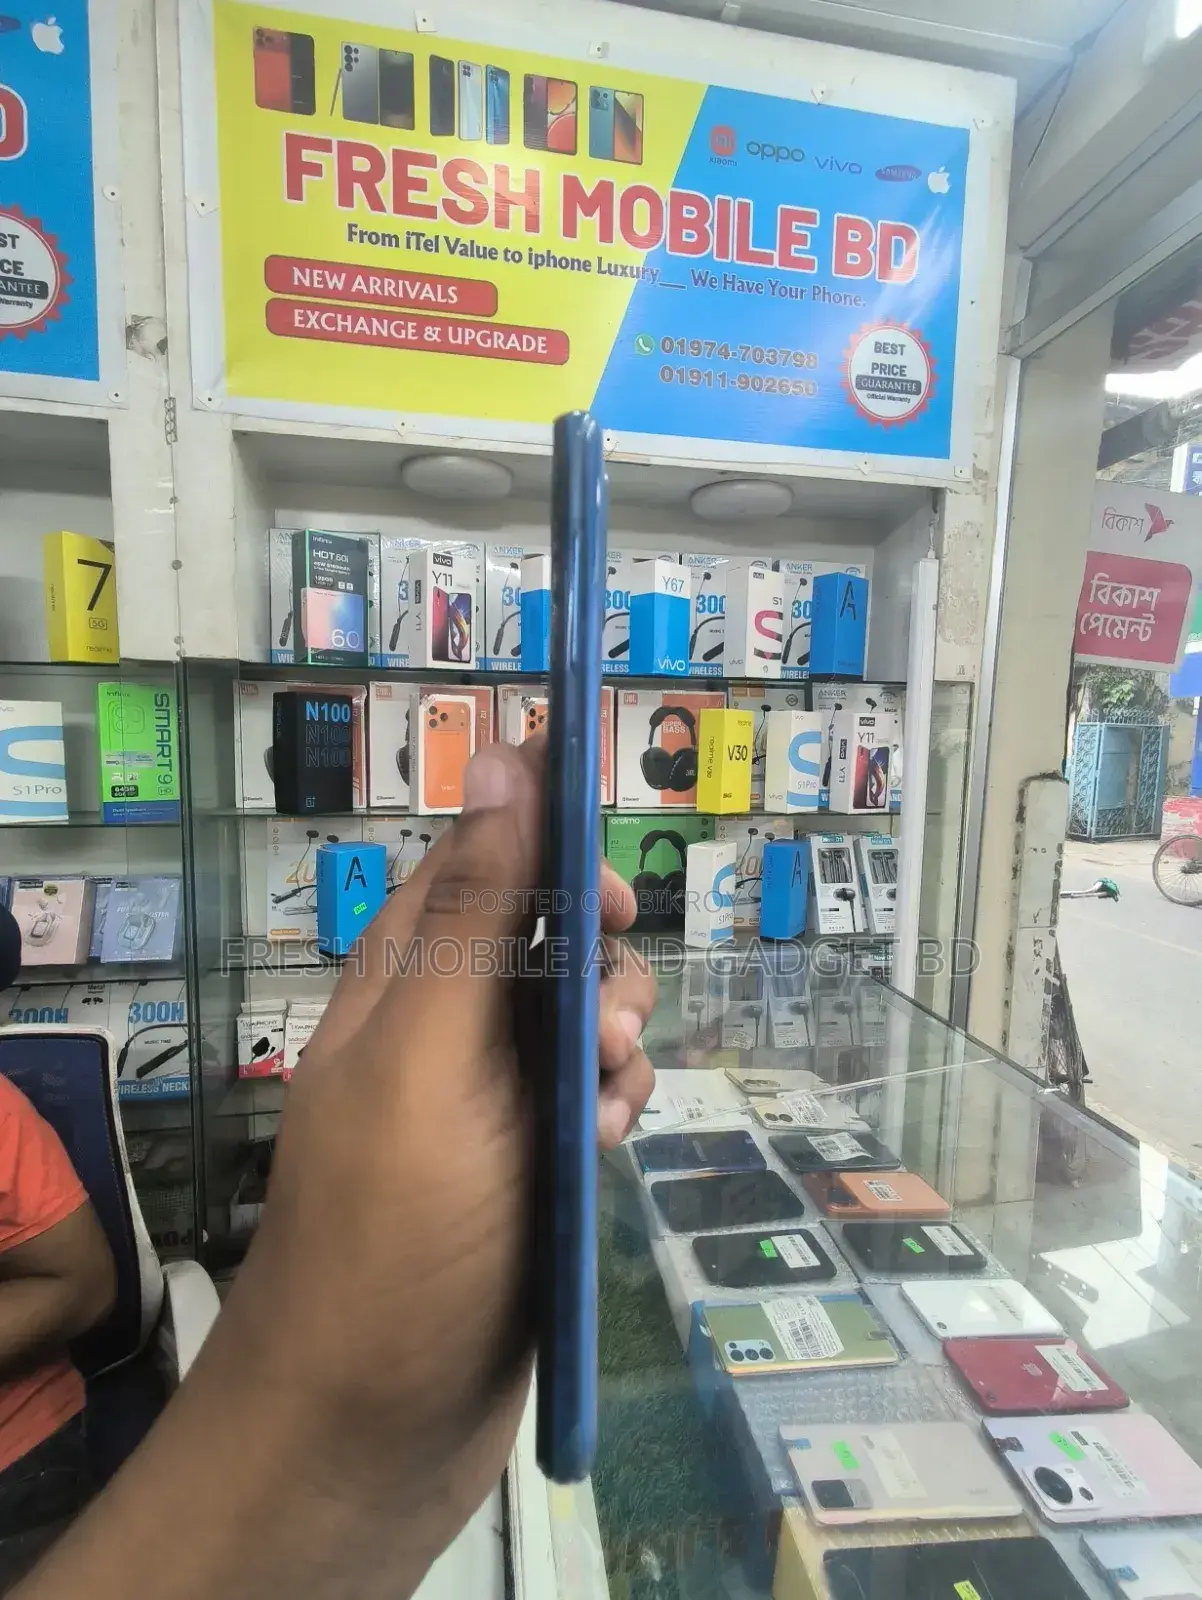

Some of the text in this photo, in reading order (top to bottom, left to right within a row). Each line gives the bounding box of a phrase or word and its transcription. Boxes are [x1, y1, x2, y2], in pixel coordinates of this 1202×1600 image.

[746, 141, 806, 163] oppo
[815, 156, 863, 175] vivo
[284, 131, 921, 284] FRESH MOBILE BD
[347, 222, 400, 249] From
[405, 230, 440, 254] iTel
[443, 235, 499, 261] Value
[503, 244, 523, 263] to
[528, 247, 592, 273] iphone
[690, 268, 718, 290] We
[722, 272, 764, 295] Have
[768, 279, 808, 301] Your
[811, 285, 867, 308] Phone.
[291, 266, 459, 305] NEW ARRIVALS
[294, 308, 549, 355] EXCHANGE & UPGRADE
[660, 336, 819, 370] 01974-703798
[873, 341, 906, 356] BEST
[871, 362, 907, 377] PRICE
[658, 365, 819, 397] 01911-902650
[860, 377, 918, 392] GUARANTEE
[1101, 506, 1145, 536] বিকাশ
[313, 549, 335, 560] HOT
[434, 553, 453, 567] vivo
[786, 563, 812, 571] ANKER
[77, 557, 112, 611] 7
[432, 570, 453, 587] Y11
[662, 575, 685, 593] Y67
[839, 580, 856, 621] A
[1089, 572, 1162, 612] বিকাশ
[331, 628, 360, 649] 60
[1079, 613, 1157, 643] পেমেন্ট
[657, 655, 686, 672] vivo
[818, 689, 847, 697] ANKER
[305, 701, 350, 723] N100
[154, 693, 173, 772] SMART
[663, 726, 686, 734] BASS
[859, 718, 875, 730] vivo
[857, 732, 875, 748] Y11
[727, 744, 748, 761] V30
[344, 856, 367, 891] A
[129, 1000, 185, 1023] 300H
